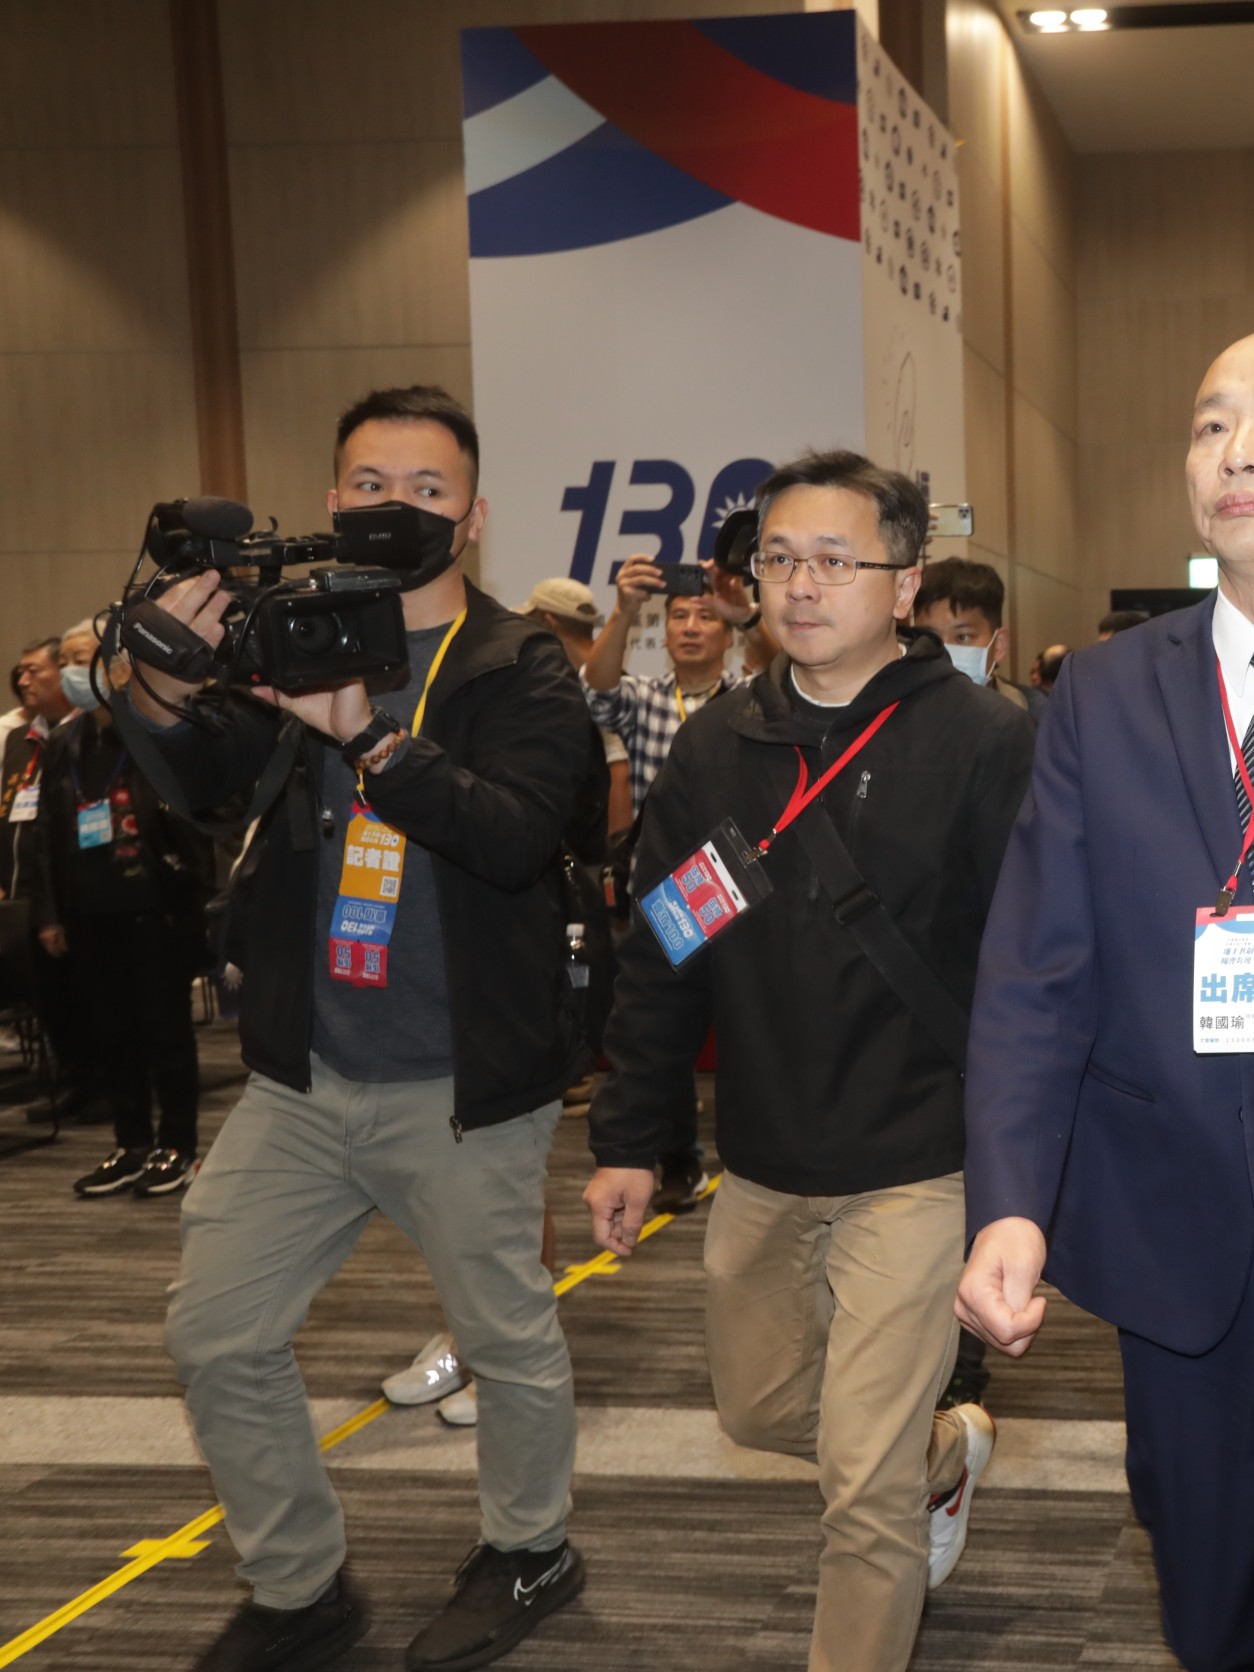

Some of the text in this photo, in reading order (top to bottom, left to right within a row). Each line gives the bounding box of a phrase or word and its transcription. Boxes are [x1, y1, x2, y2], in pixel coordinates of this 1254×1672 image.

[133, 621, 174, 655] Panasonic
[379, 833, 400, 847] 130
[346, 845, 401, 872] 記者證
[681, 873, 698, 893] 50
[699, 905, 715, 925] 50
[679, 920, 694, 938] 130
[1200, 1015, 1245, 1030] 韓國瑜
